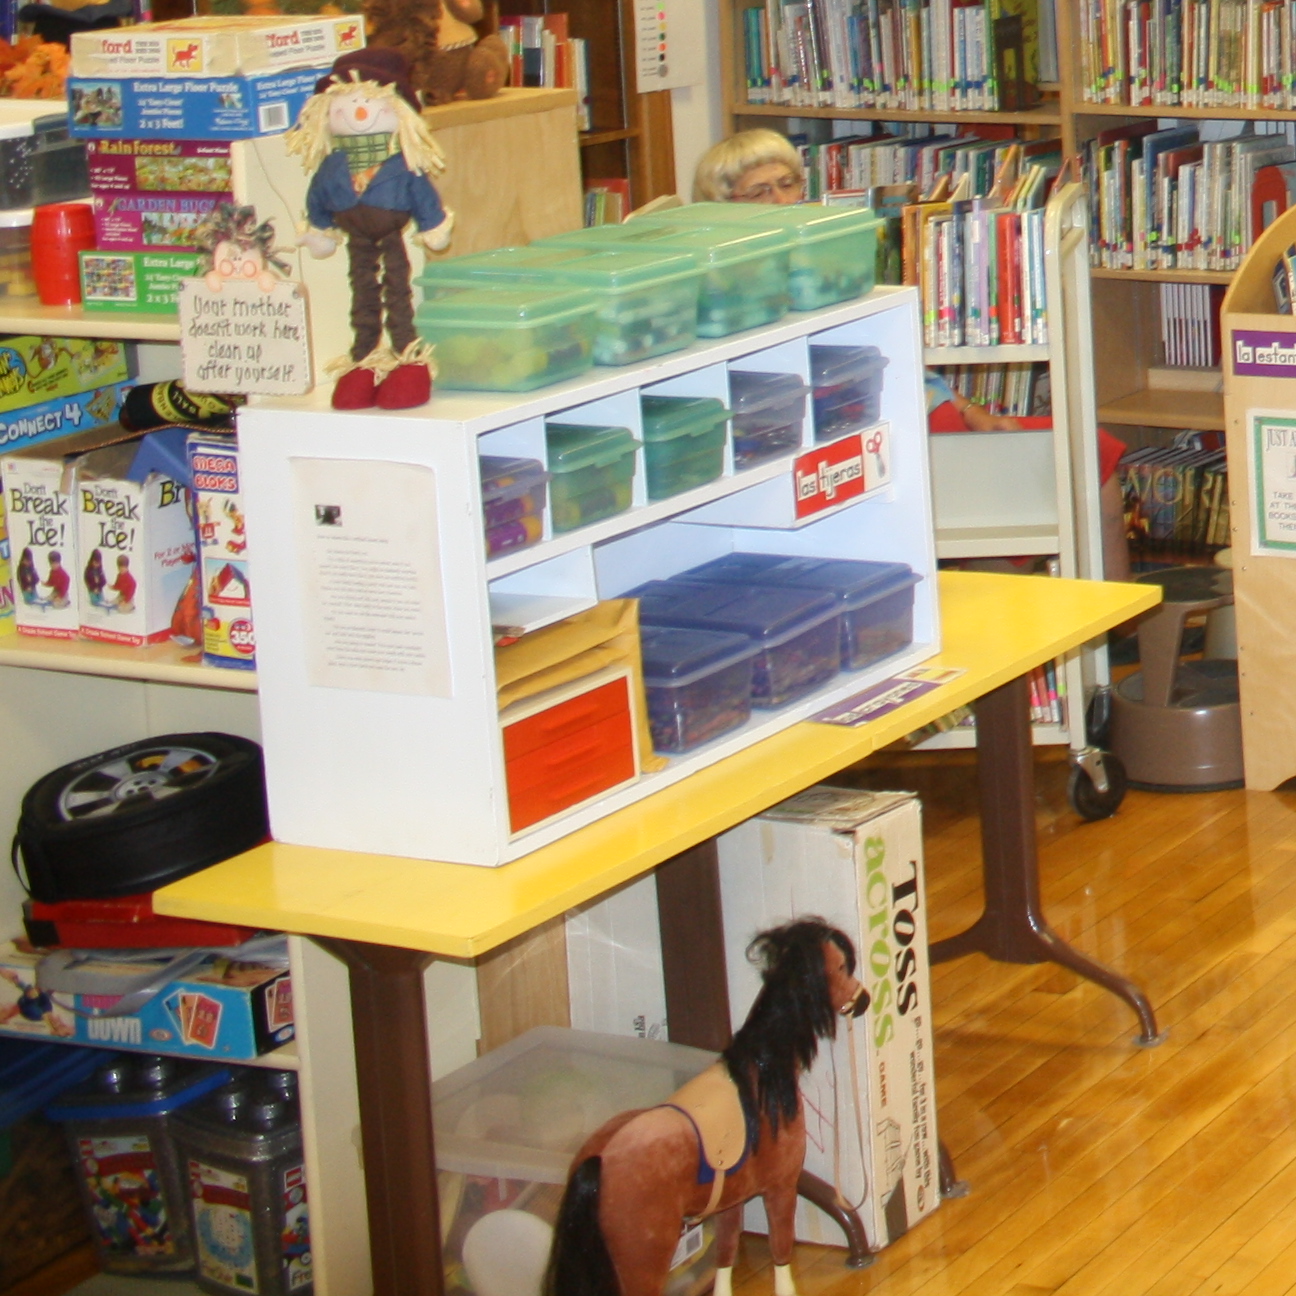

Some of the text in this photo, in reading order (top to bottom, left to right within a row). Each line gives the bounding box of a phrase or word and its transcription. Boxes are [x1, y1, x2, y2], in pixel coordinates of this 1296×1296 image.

[101, 39, 132, 55] ford
[133, 82, 239, 94] Extra Large Floor Puzzle
[117, 198, 176, 212] GARDEN
[143, 258, 195, 270] Extra Large
[232, 295, 291, 318] mother
[234, 321, 267, 338] work
[208, 340, 263, 363] clean up
[1238, 344, 1251, 362] la
[197, 359, 232, 381] after
[0, 403, 82, 445] CONNECT 4
[1265, 428, 1287, 451] JUST
[192, 456, 235, 473] MEGA
[194, 474, 237, 491] BLOKS
[798, 461, 861, 497] las tijeras
[23, 482, 46, 495] Don't
[95, 485, 118, 498] Don't
[159, 481, 182, 509] Br
[1273, 491, 1294, 501] TAKE
[10, 488, 69, 516] Break
[80, 489, 140, 521] Break
[1269, 501, 1282, 509] AT
[39, 516, 53, 528] the
[111, 518, 125, 530] the
[27, 520, 65, 547] Ice!
[99, 522, 134, 551] Ice!
[231, 630, 255, 645] 350
[864, 836, 894, 1049] across
[892, 860, 919, 1016] TOSS
[879, 1061, 887, 1108] GAME
